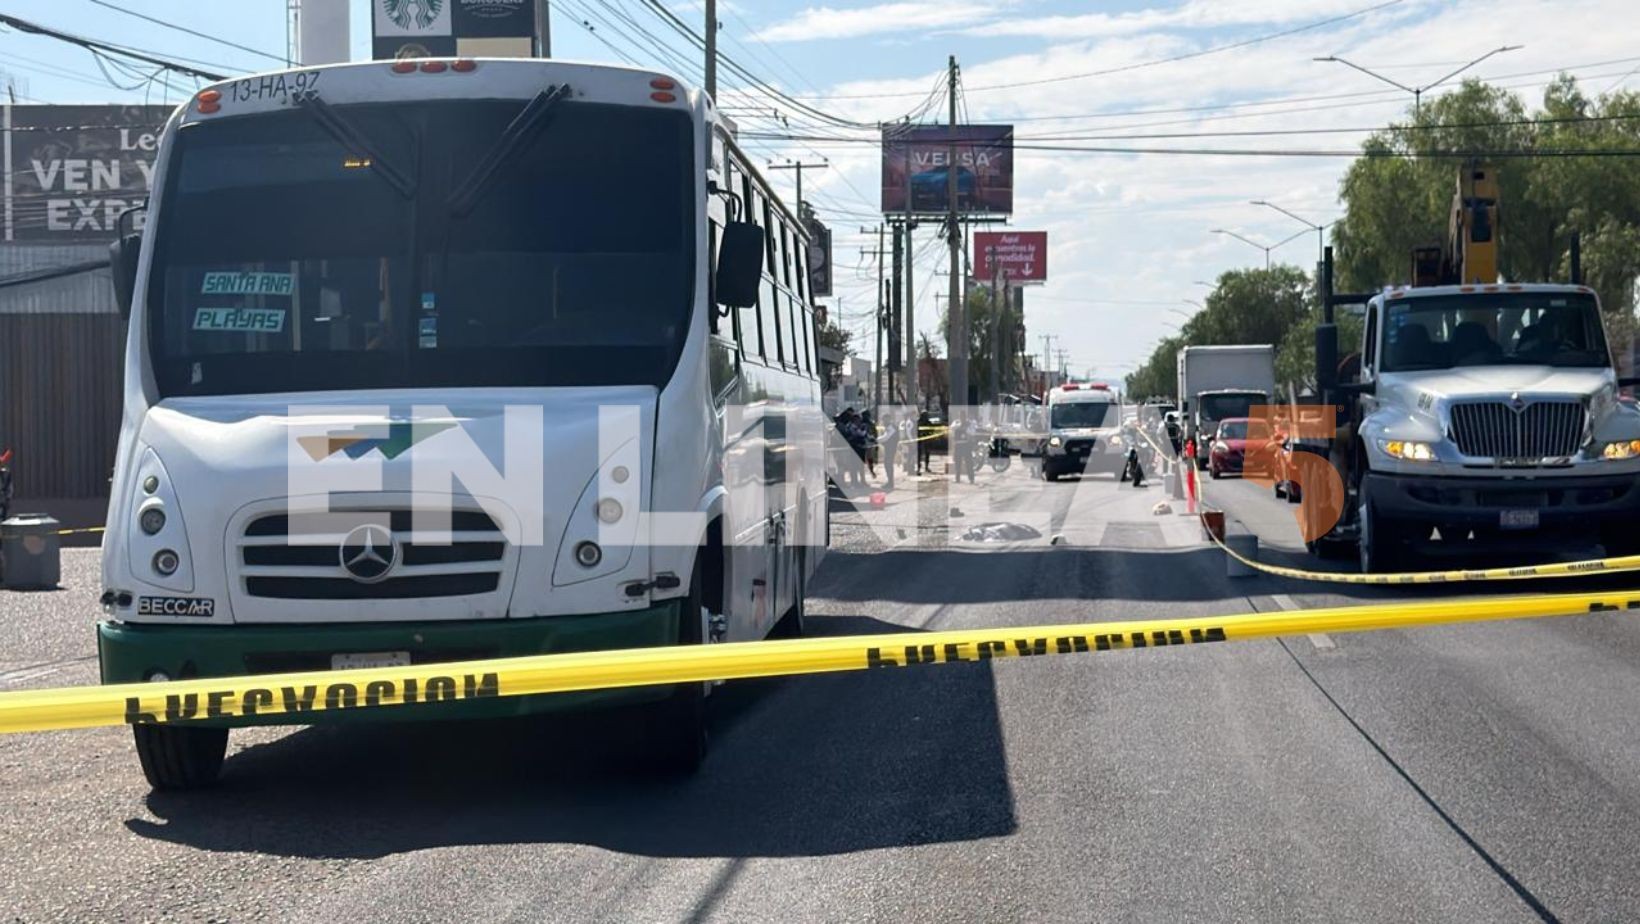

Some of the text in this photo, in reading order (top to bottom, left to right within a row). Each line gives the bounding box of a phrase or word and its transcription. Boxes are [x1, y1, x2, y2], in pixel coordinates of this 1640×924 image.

[230, 72, 320, 102] 13-HA-97
[32, 160, 120, 190] VEN
[205, 275, 293, 293] SANTA ANA
[196, 311, 279, 329] PLAYAS
[138, 598, 214, 615] BECCAR
